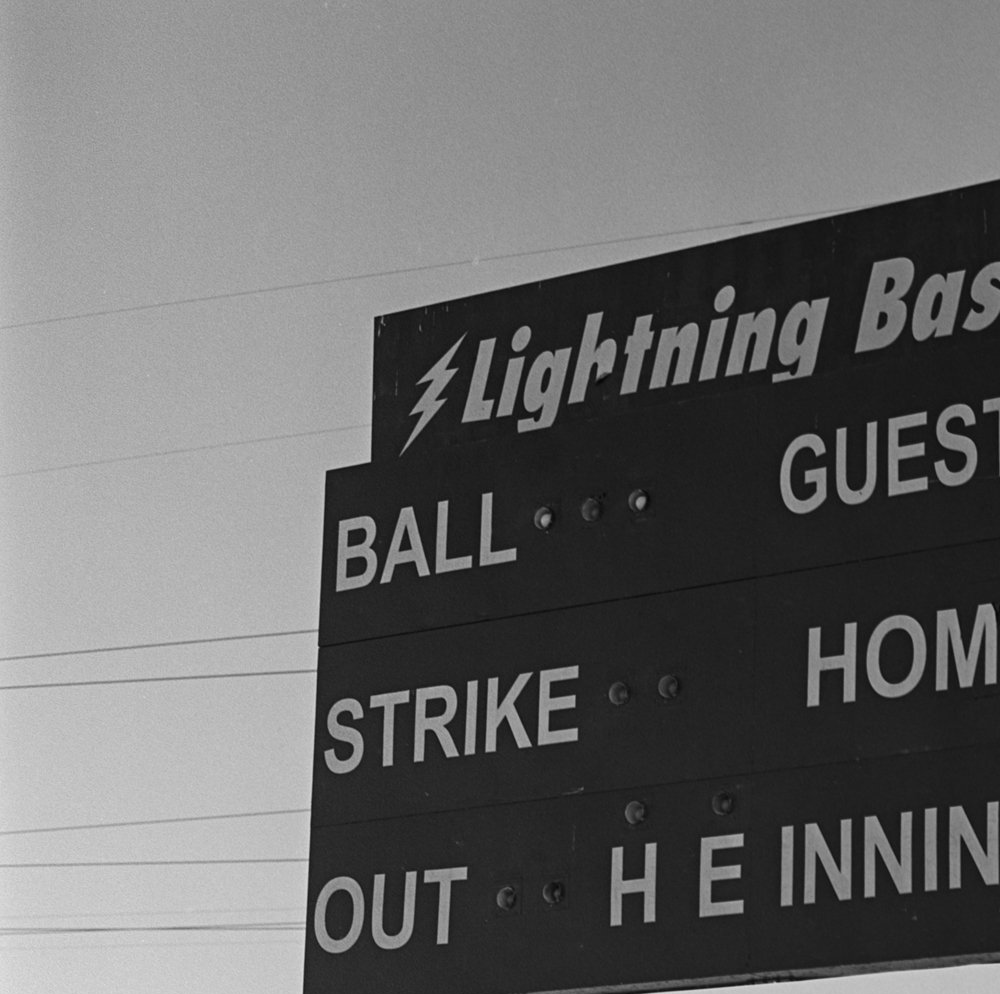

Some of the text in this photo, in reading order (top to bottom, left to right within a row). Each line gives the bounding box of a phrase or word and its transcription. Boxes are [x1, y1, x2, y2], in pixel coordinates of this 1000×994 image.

[462, 286, 829, 433] Lightning
[336, 492, 516, 592] BALL
[324, 665, 579, 774] STRIKE
[314, 867, 467, 953] OUT
[610, 843, 657, 926] H
[699, 833, 744, 917] E
